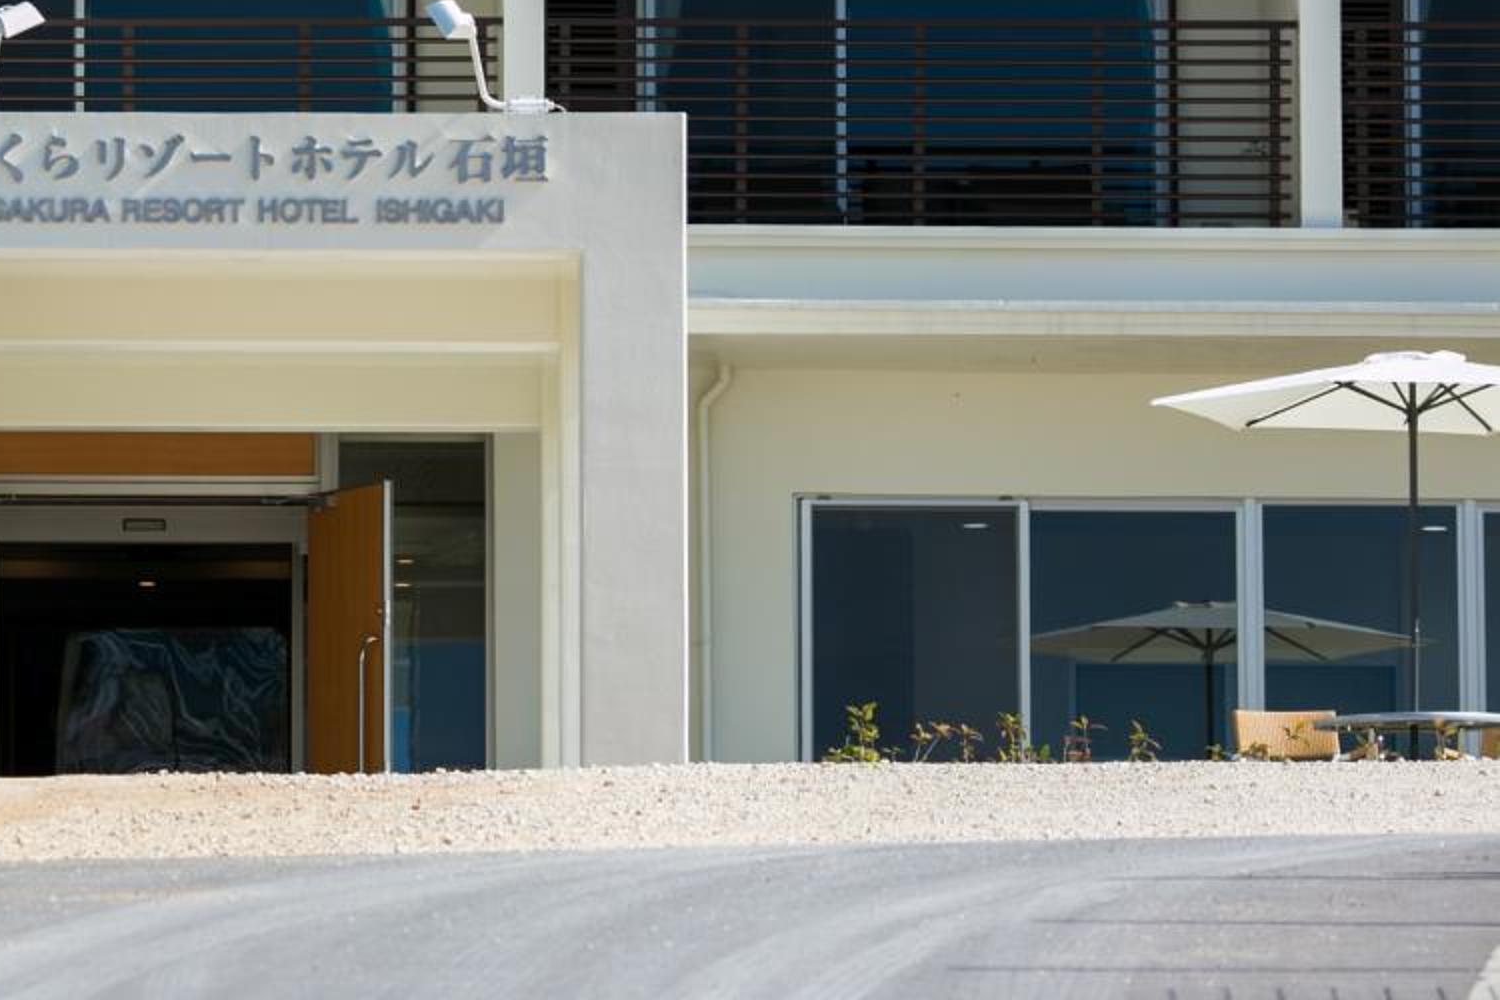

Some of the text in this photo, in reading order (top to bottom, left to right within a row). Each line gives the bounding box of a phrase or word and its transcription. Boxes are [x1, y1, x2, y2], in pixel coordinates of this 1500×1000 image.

[121, 198, 245, 224] RESORT
[257, 198, 359, 224] HOTEL
[375, 198, 506, 225] ISHIGAKI
